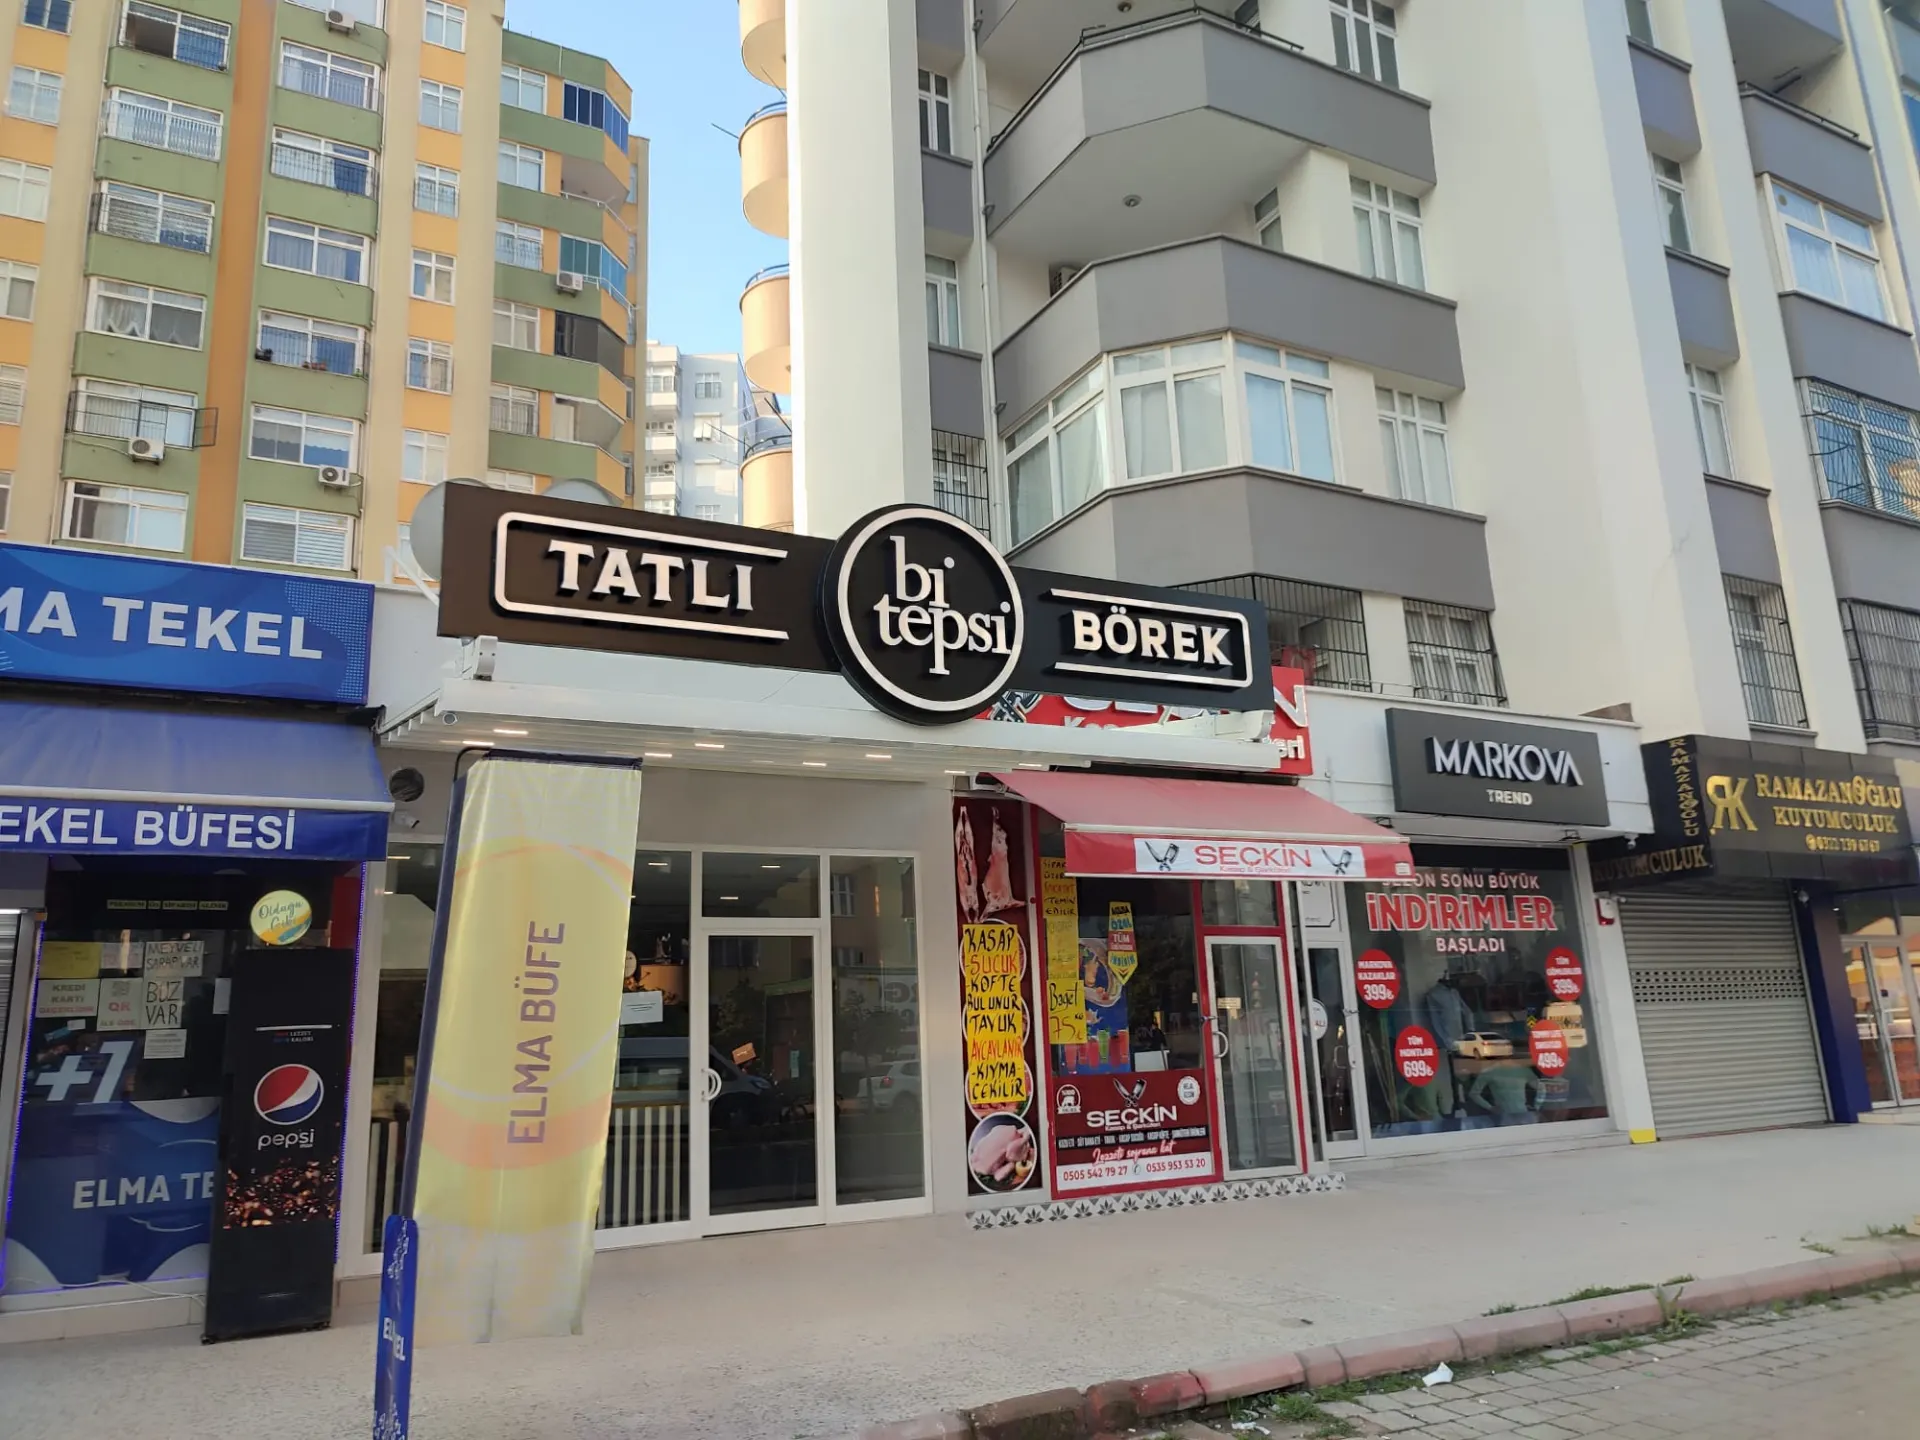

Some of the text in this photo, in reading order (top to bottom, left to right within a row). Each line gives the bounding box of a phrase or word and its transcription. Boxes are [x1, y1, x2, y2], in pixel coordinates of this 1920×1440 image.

[548, 539, 754, 611] TATLI
[889, 535, 955, 608] bi
[103, 596, 322, 660] TEKEL
[873, 594, 1012, 675] tepsi
[1072, 605, 1233, 666] BÖREK
[1432, 736, 1584, 786] MARKOVA
[1486, 788, 1533, 806] TREND
[1754, 773, 1902, 810] RAMAZANOĞLU
[134, 804, 295, 850] BÜFESİ
[1773, 805, 1899, 833] KUYUMCULUK
[1193, 843, 1313, 868] SEÇKİN
[1440, 874, 1484, 888] SONU
[1488, 872, 1540, 889] BÜYÜK
[1365, 892, 1558, 931] İNDİRİMLER
[965, 927, 1016, 953] KASAP
[1436, 937, 1506, 954] BAŞLADI
[146, 981, 181, 1002] BUZ
[145, 1003, 178, 1026] VAR
[969, 1011, 1017, 1036] TAVUK
[507, 920, 565, 1144] ELMA BÜFE
[1086, 1102, 1177, 1128] SEÇKİN
[257, 1129, 315, 1150] pepsi
[1063, 1157, 1206, 1181] 0505 542 79 27 0535 953 53 20
[73, 1175, 170, 1209] ELMA
